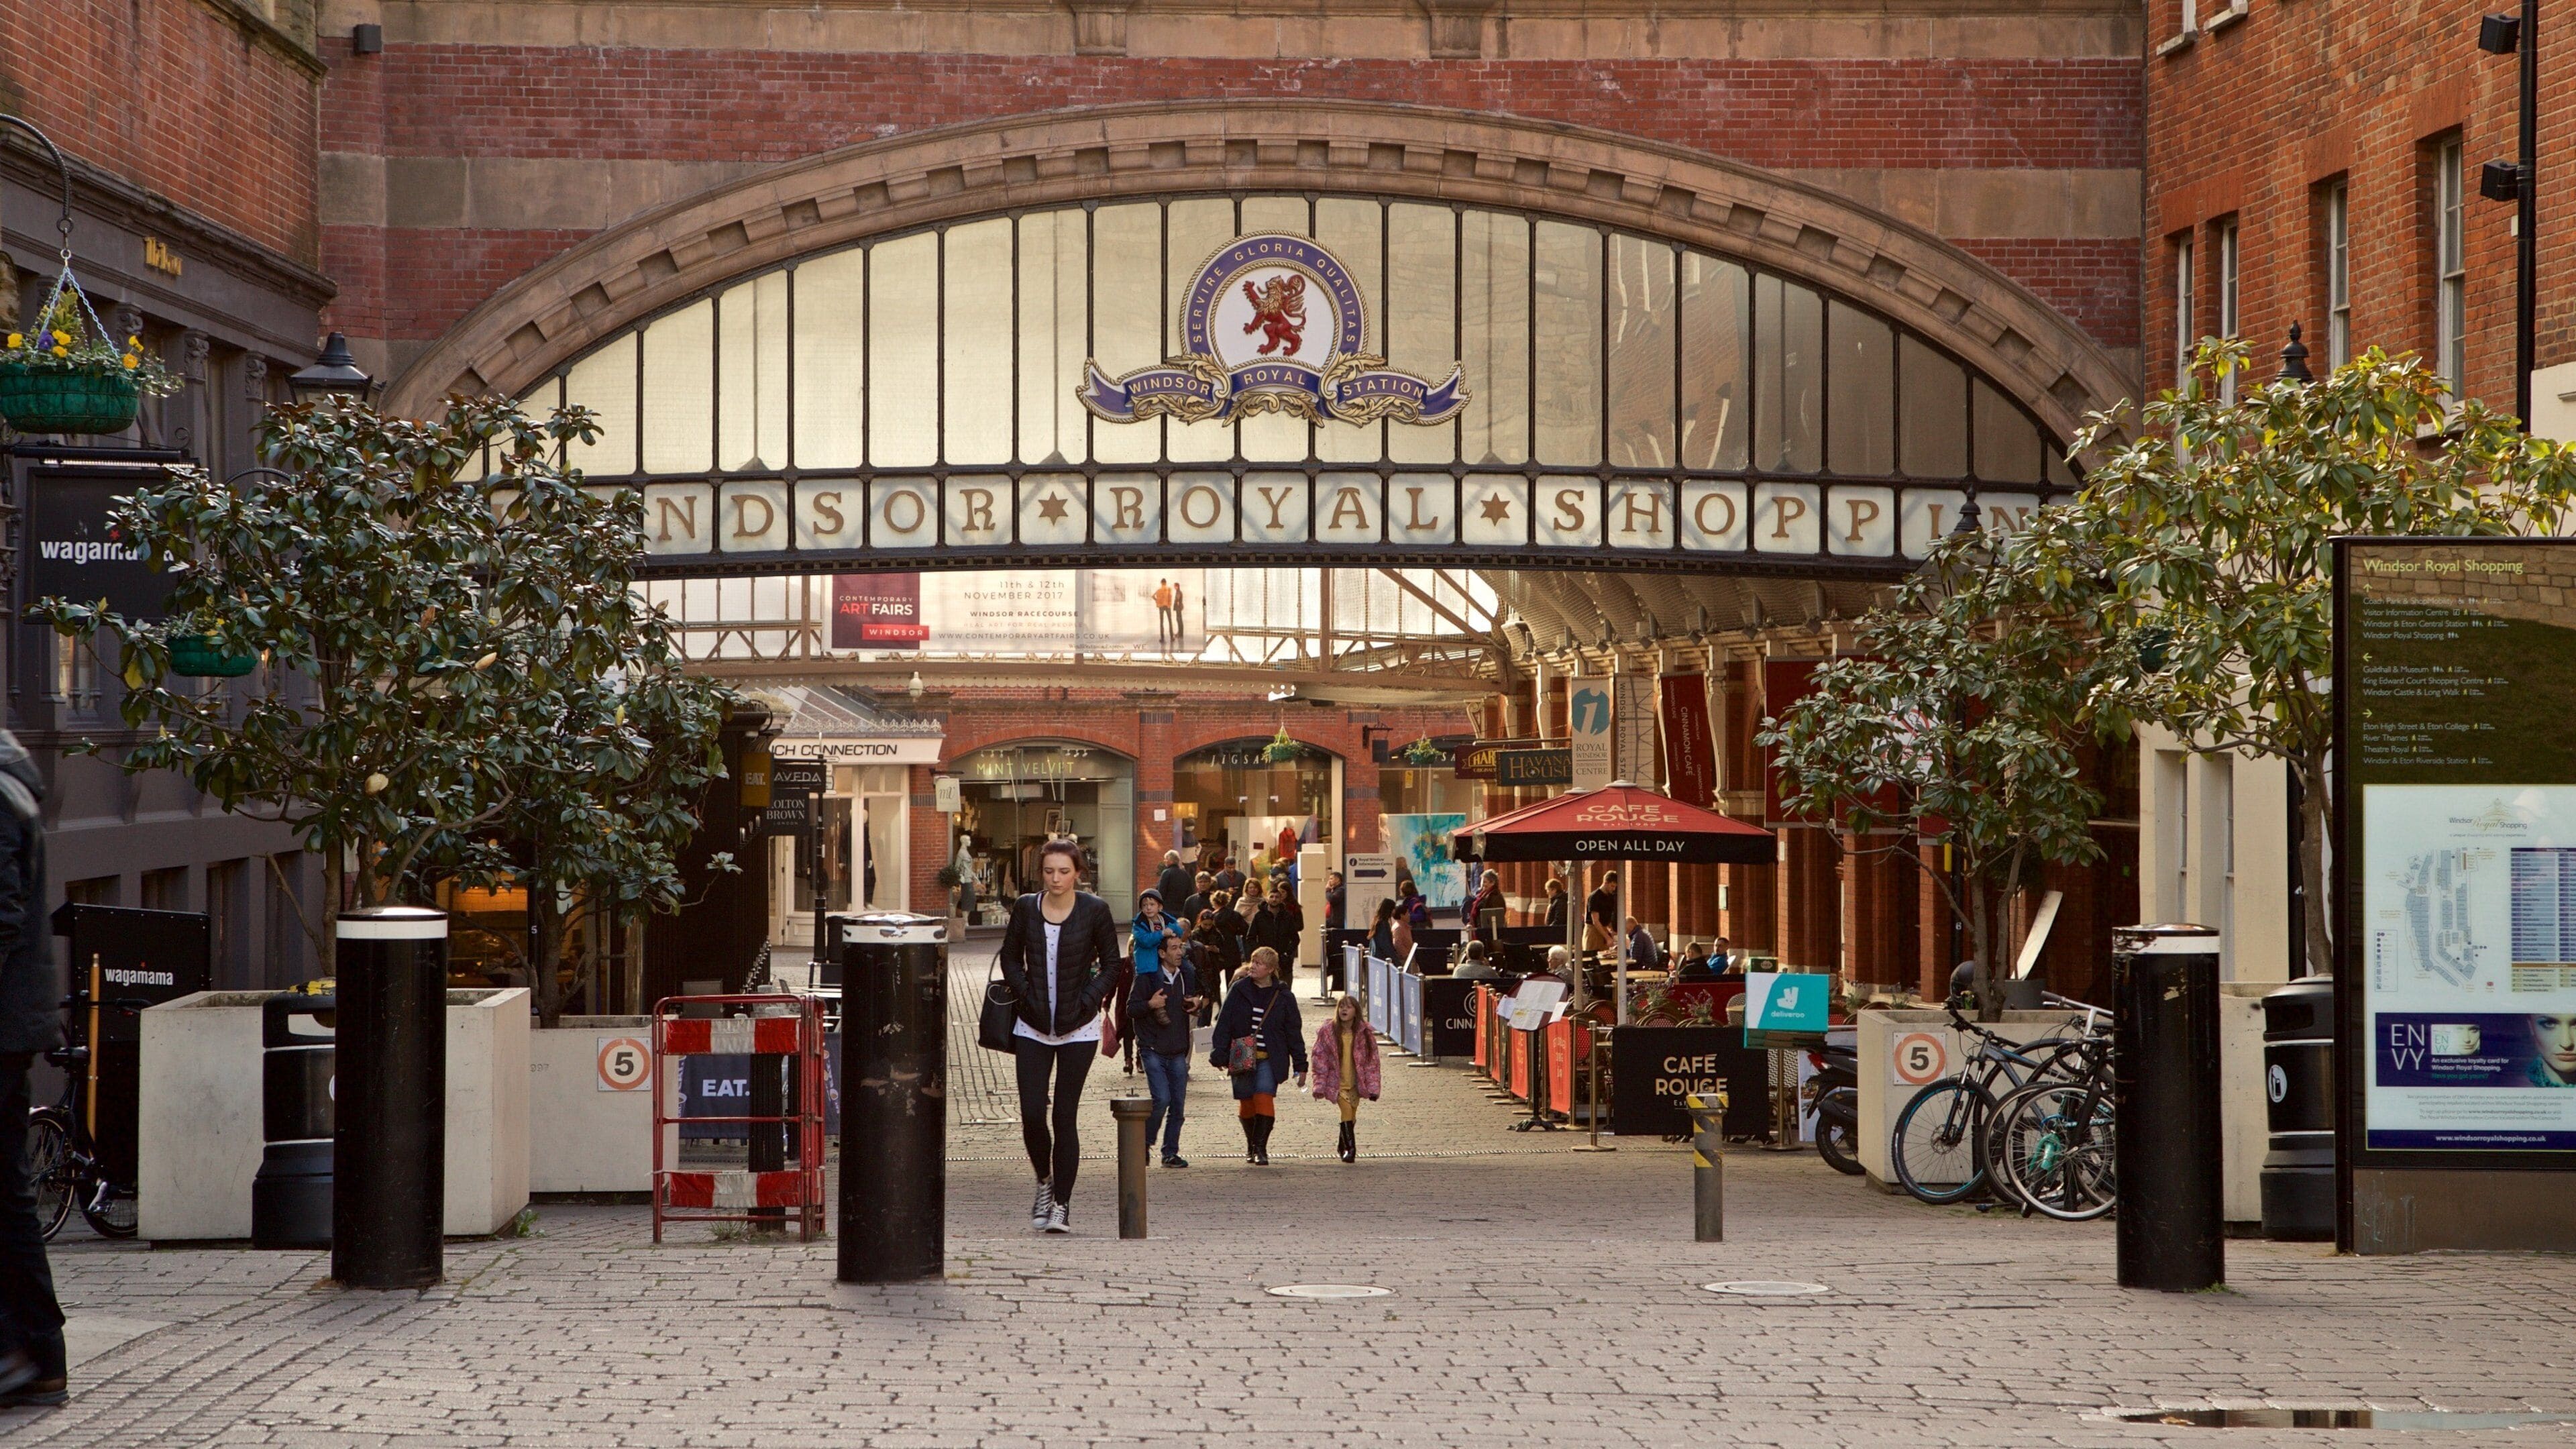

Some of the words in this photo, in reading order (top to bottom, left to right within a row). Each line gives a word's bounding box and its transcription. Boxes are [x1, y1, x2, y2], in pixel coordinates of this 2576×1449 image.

[1193, 267, 1224, 343] SERVIRE
[1235, 243, 1304, 262] GLORIA
[1317, 258, 1356, 343] QUALITAS
[1128, 377, 1211, 395] WINDSOR
[1243, 370, 1305, 386] ROYAL
[1342, 378, 1424, 398] STATION
[1110, 486, 1439, 531] ROYAL
[40, 541, 174, 565] wagamaa
[2363, 559, 2420, 572] Windsor
[2425, 559, 2460, 575] Royal
[2465, 559, 2524, 575] Shopping
[964, 592, 1031, 600] NOVEMBER
[1037, 592, 1063, 600] 2017
[839, 603, 869, 614] ART
[872, 603, 913, 616] FAIRS
[869, 629, 924, 637] WINDSOR
[2394, 632, 2412, 640] Royal
[2414, 632, 2444, 640] Shopping
[2363, 677, 2377, 686] King
[2379, 677, 2404, 685] Edward
[2406, 677, 2426, 685] Court
[2428, 677, 2459, 686] Shopping
[2461, 677, 2485, 685] Centre
[2424, 689, 2441, 698] Long
[1680, 706, 1692, 754] CINNAMON
[2381, 723, 2396, 732] High
[2445, 723, 2470, 732] College
[800, 743, 898, 756] CONNECTION
[1576, 743, 1607, 752] ROYAL
[2391, 746, 2410, 755] Royal
[976, 762, 1014, 775] MINT
[1022, 761, 1075, 775] VELVET
[1576, 767, 1607, 775] CENTRE
[745, 772, 766, 786] EAT.
[769, 799, 805, 809] OLTON
[765, 810, 805, 820] BROWN
[1576, 813, 1680, 823] ROUGE
[2500, 822, 2528, 830] Shopping
[1576, 840, 1618, 852] OPEN
[1623, 840, 1651, 851] ALL
[1656, 840, 1686, 853] DAY
[531, 925, 537, 934] 5
[105, 968, 174, 987] wagamama
[1770, 1010, 1805, 1018] deliveroo
[2391, 1024, 2425, 1046] EN
[2434, 1034, 2449, 1044] EN
[614, 1051, 635, 1077] 5
[1663, 1053, 1717, 1074] CAFÉ
[1909, 1046, 1929, 1071] 5
[2391, 1048, 2426, 1071] VY
[2473, 1065, 2502, 1073] Shopping.
[702, 1079, 751, 1097] EAT.
[1655, 1077, 1729, 1096] ROUGE
[2435, 1135, 2546, 1143] www.windsorroyalshopping.co.uk
